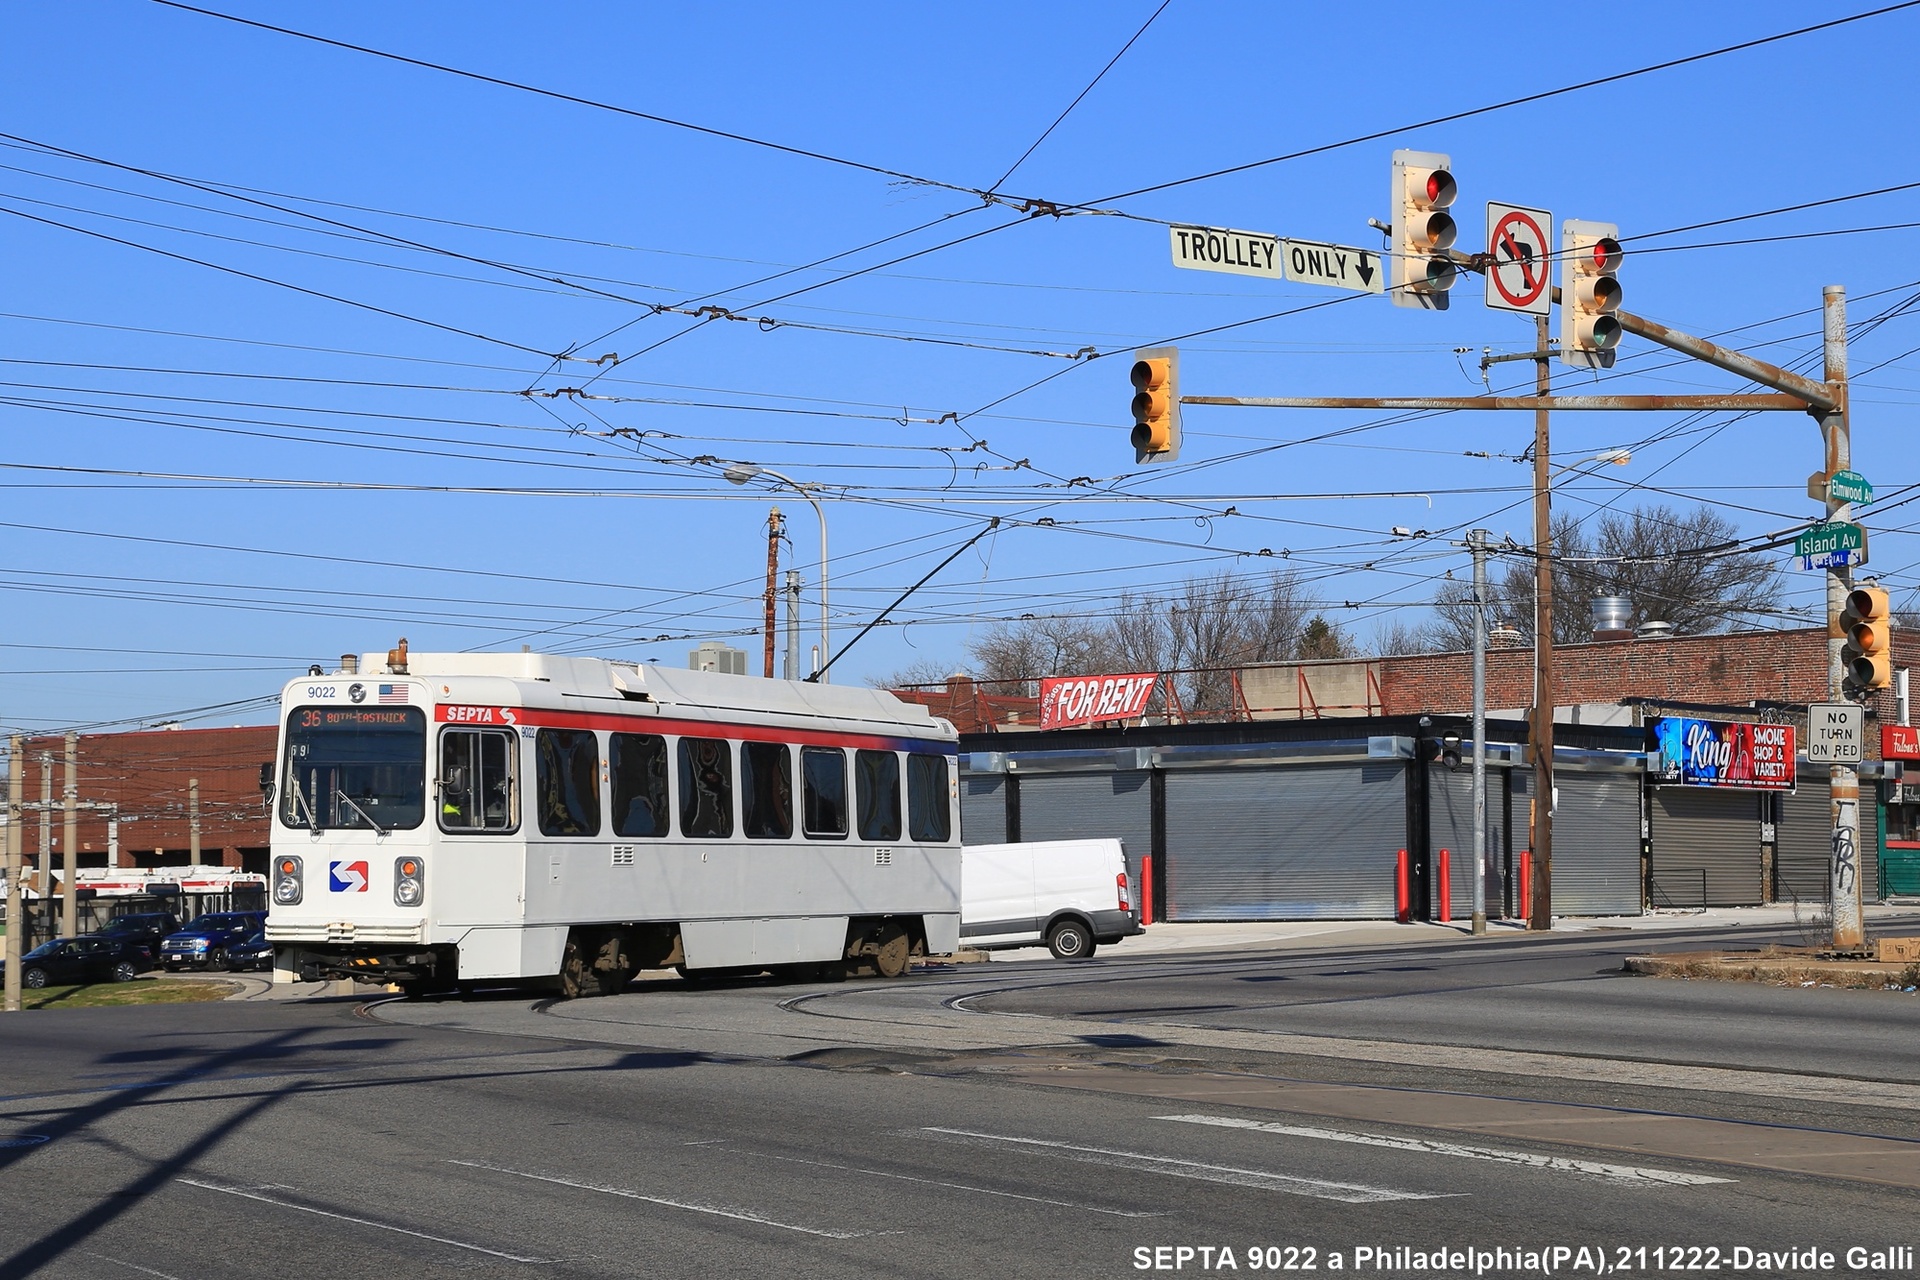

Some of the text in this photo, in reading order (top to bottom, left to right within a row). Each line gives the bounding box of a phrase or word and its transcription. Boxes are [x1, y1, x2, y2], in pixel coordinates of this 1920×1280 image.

[1177, 231, 1347, 280] TROLLEY ONLY
[1832, 479, 1862, 500] Elmwood
[1800, 533, 1856, 554] Island Av
[308, 686, 336, 698] 9022
[1057, 677, 1155, 721] FOR RENT
[301, 709, 322, 727] 36
[446, 706, 493, 722] SEPTA
[1827, 712, 1848, 724] NO
[521, 726, 535, 738] 9022
[1754, 727, 1786, 746] SMOKE
[1820, 728, 1852, 739] TURN
[1687, 724, 1734, 778] King
[1754, 746, 1784, 760] SHOP &
[1812, 744, 1857, 756] ON RED
[1753, 761, 1786, 777] VARIETY
